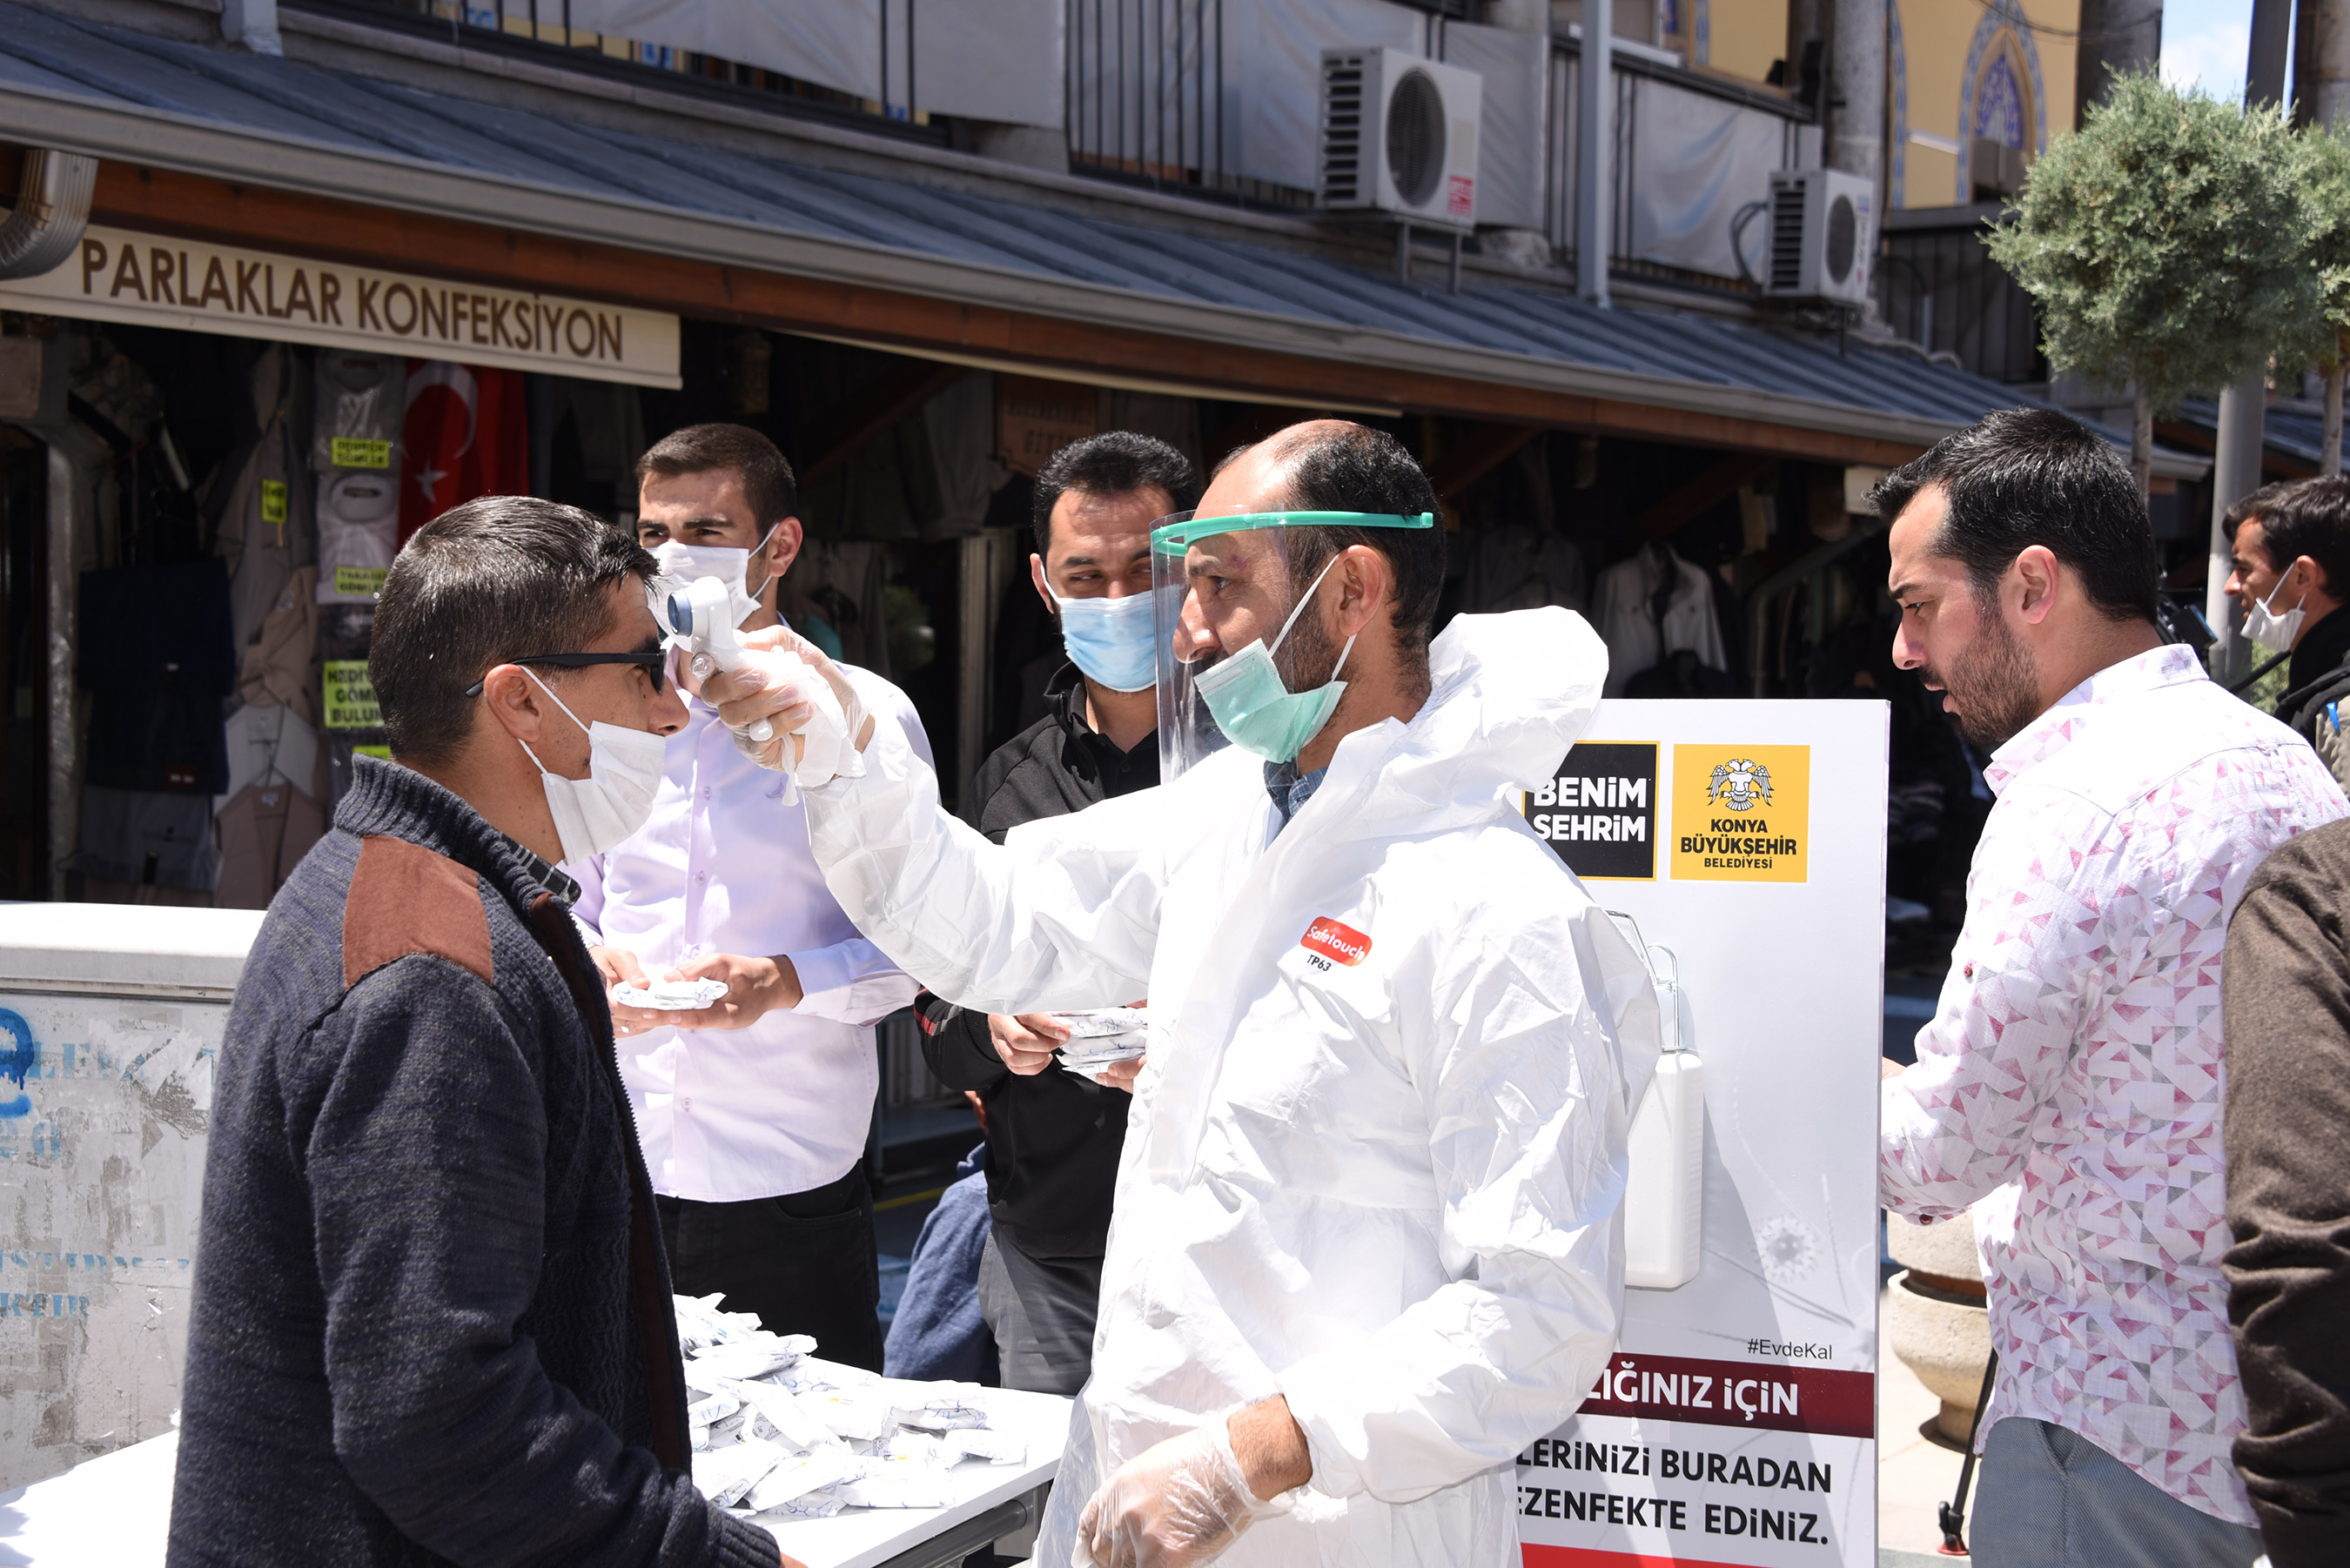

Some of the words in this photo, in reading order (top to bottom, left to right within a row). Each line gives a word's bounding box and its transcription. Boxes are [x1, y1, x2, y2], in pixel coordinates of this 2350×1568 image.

[82, 238, 343, 326] PARLAKLAR
[357, 277, 623, 362] KONFEKSİYON
[1710, 818, 1769, 834] KONYA
[1680, 833, 1797, 857] BÜYÜKŞEHİR
[1703, 856, 1773, 869] BELEDİYESİ
[1306, 926, 1366, 961] Safetouch
[1306, 955, 1332, 972] TP63
[1748, 1337, 1833, 1361] #EvdeKal
[1661, 1448, 1831, 1493] BURADAN
[1517, 1485, 1687, 1531] ZENFEKTE
